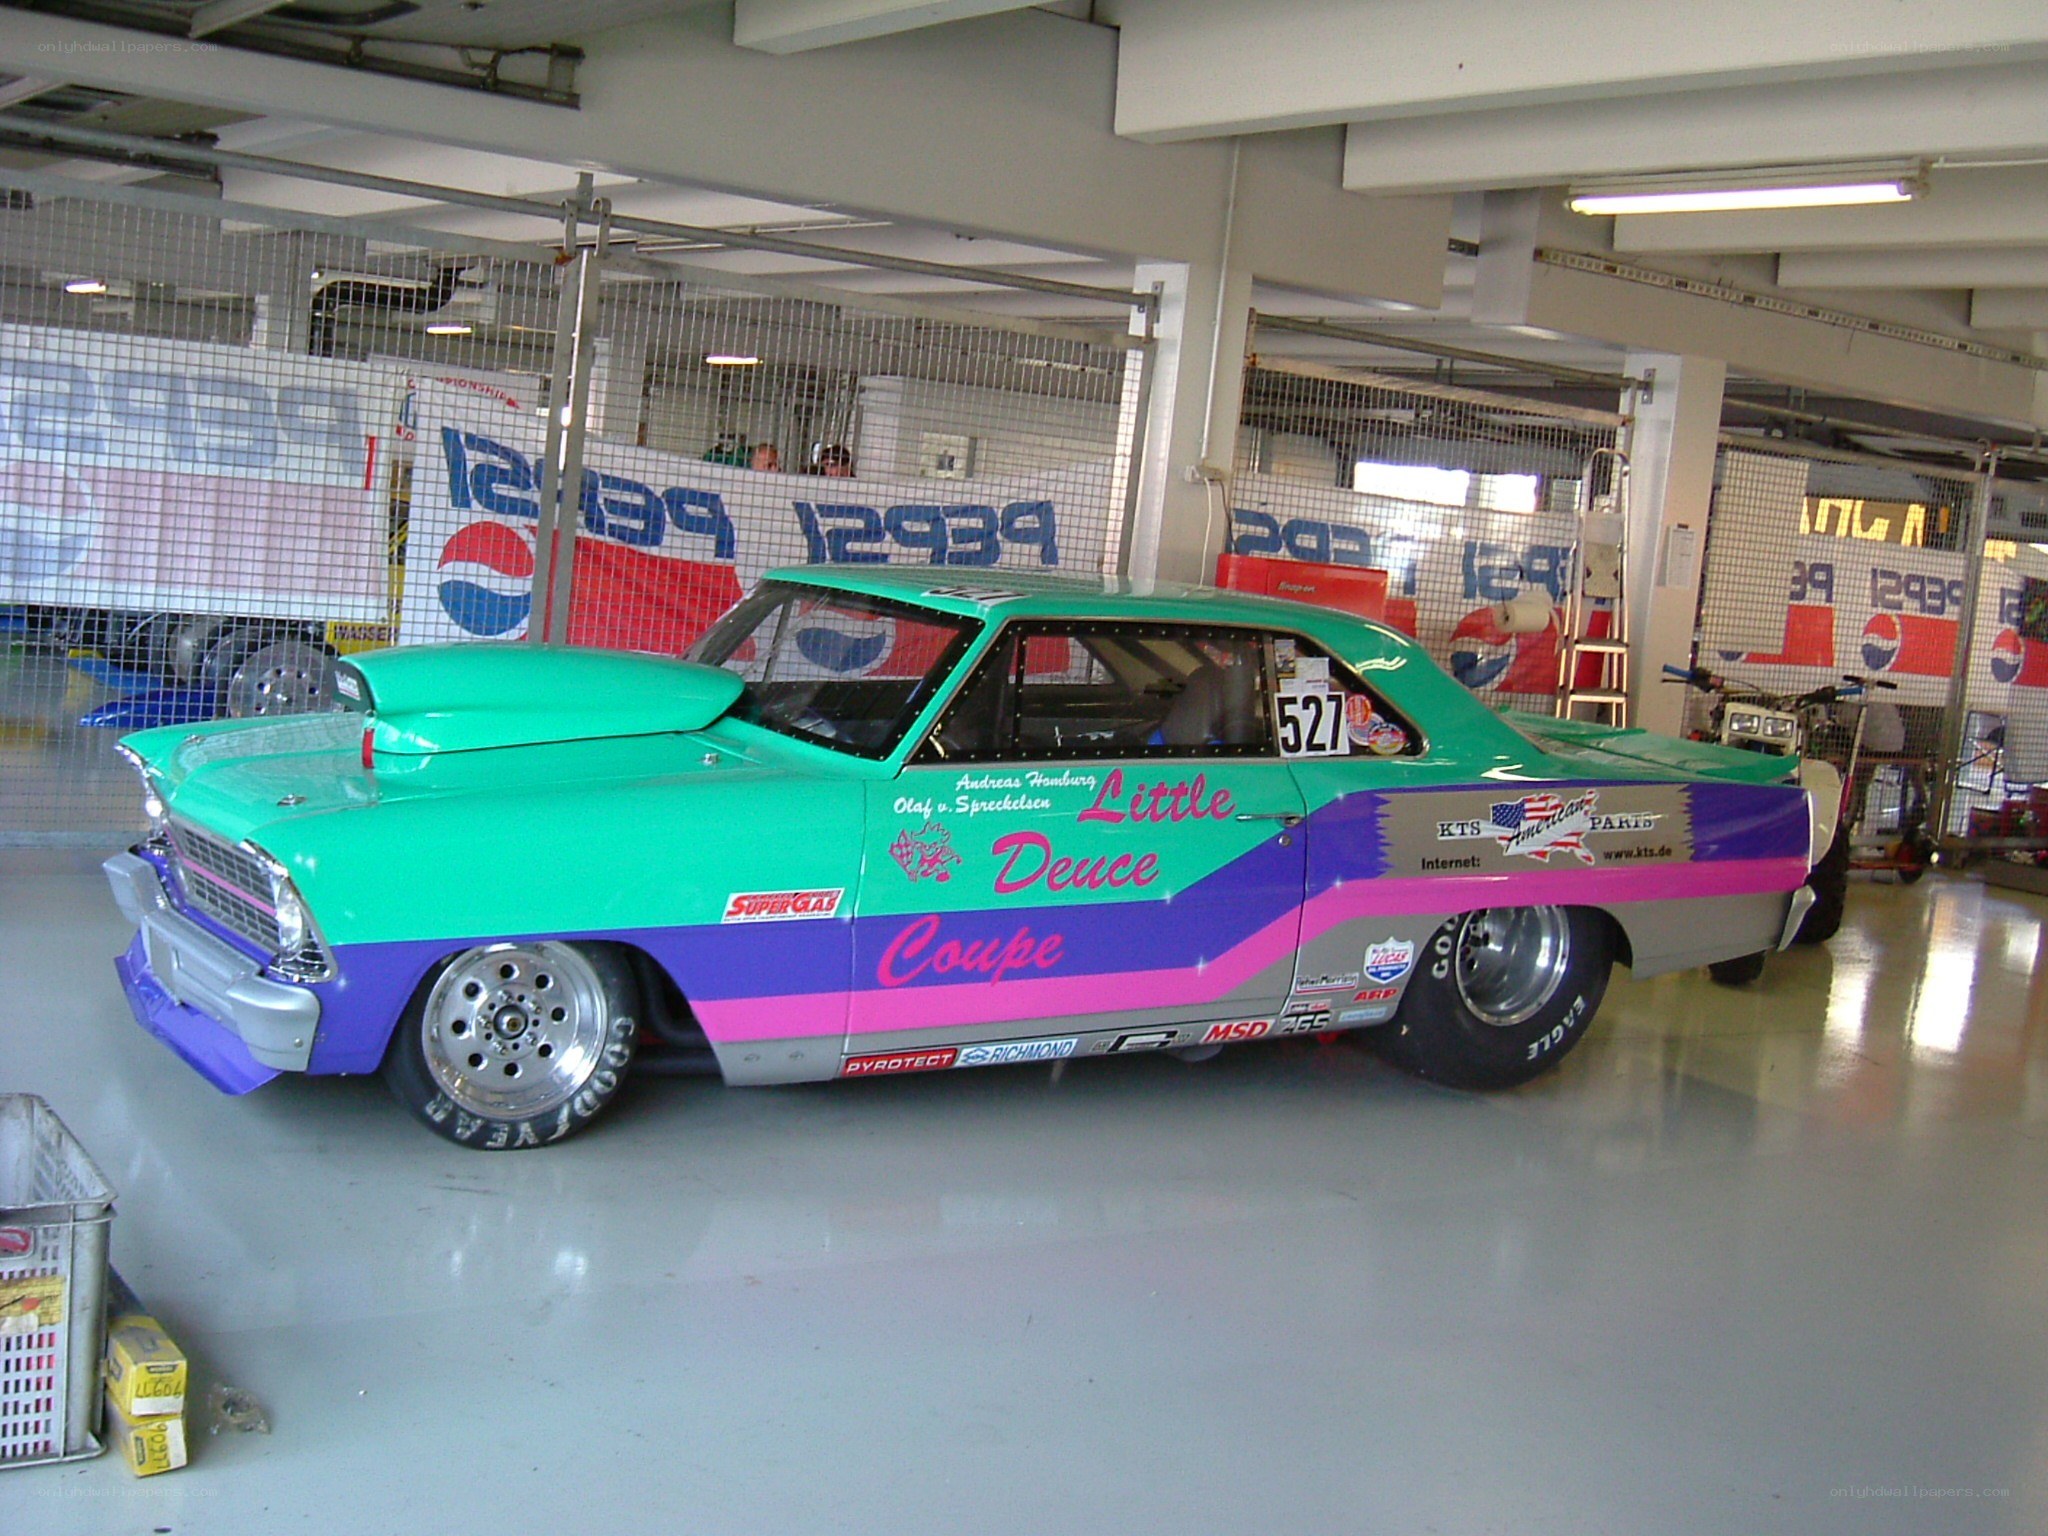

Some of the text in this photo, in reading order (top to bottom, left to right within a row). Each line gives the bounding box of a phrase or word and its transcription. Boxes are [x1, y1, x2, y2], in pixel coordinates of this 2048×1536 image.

[1277, 694, 1343, 753] 527
[956, 770, 1098, 791] Andreas Homburg
[1077, 768, 1236, 823] Little
[893, 797, 933, 819] Olaf
[1439, 822, 1481, 837] KTS
[1506, 797, 1587, 850] American
[991, 830, 1160, 894] Deuce
[1421, 846, 1672, 870] Internet: www.kts.de
[876, 913, 1066, 987] Coupe
[1204, 1022, 1269, 1042] MSD
[1527, 995, 1587, 1061] EAGLE
[846, 1053, 954, 1073] PYROTECT
[989, 1040, 1074, 1062] RICHMOND
